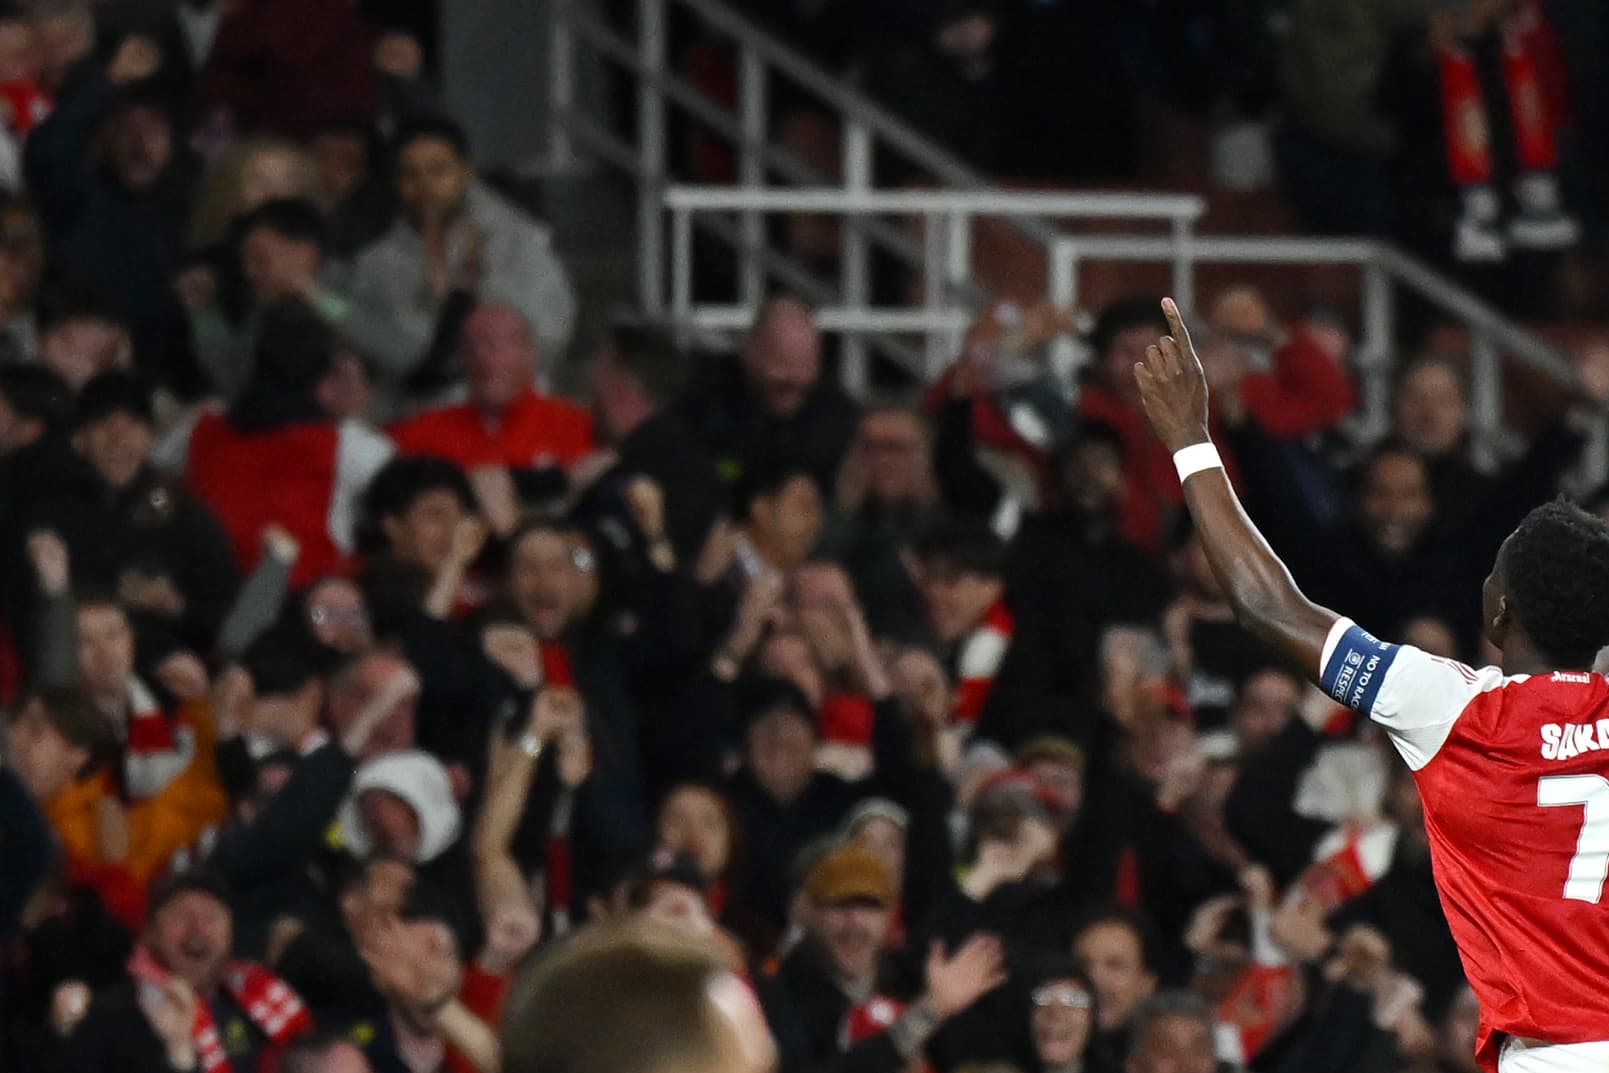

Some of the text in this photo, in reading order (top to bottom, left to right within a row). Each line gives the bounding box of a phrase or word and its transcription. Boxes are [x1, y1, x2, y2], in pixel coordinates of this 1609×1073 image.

[1366, 654, 1381, 671] NO
[1335, 666, 1354, 703] RESPEC
[1359, 670, 1372, 687] TO
[1551, 671, 1590, 684] Arsenal
[1351, 685, 1365, 709] RAC
